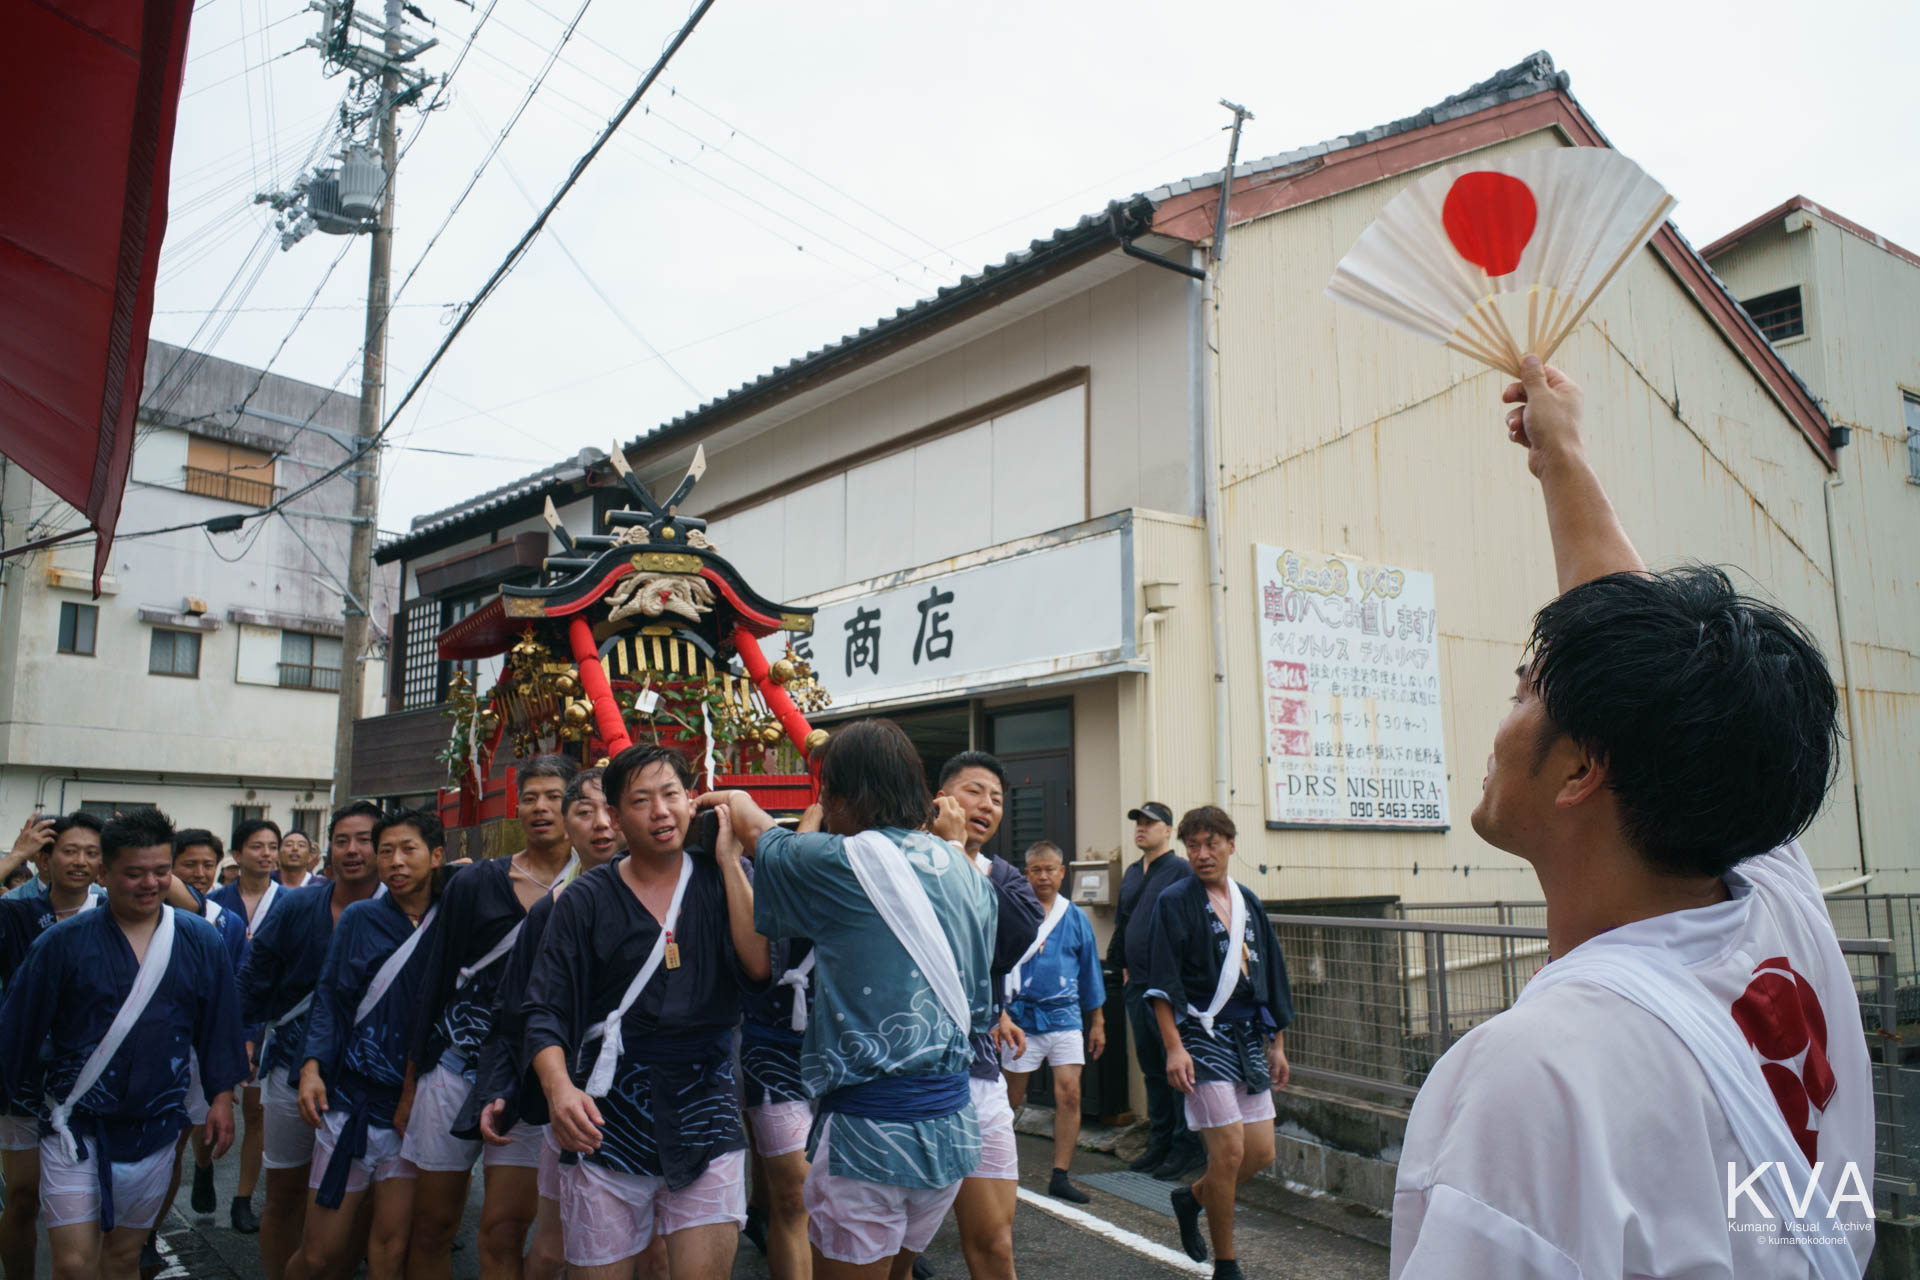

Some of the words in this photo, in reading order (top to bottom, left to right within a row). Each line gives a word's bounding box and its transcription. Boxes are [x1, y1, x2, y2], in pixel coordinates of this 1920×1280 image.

[1287, 774, 1336, 797] DRS
[1347, 777, 1438, 800] NISHIURA
[1350, 801, 1440, 820] 090-5463-5386
